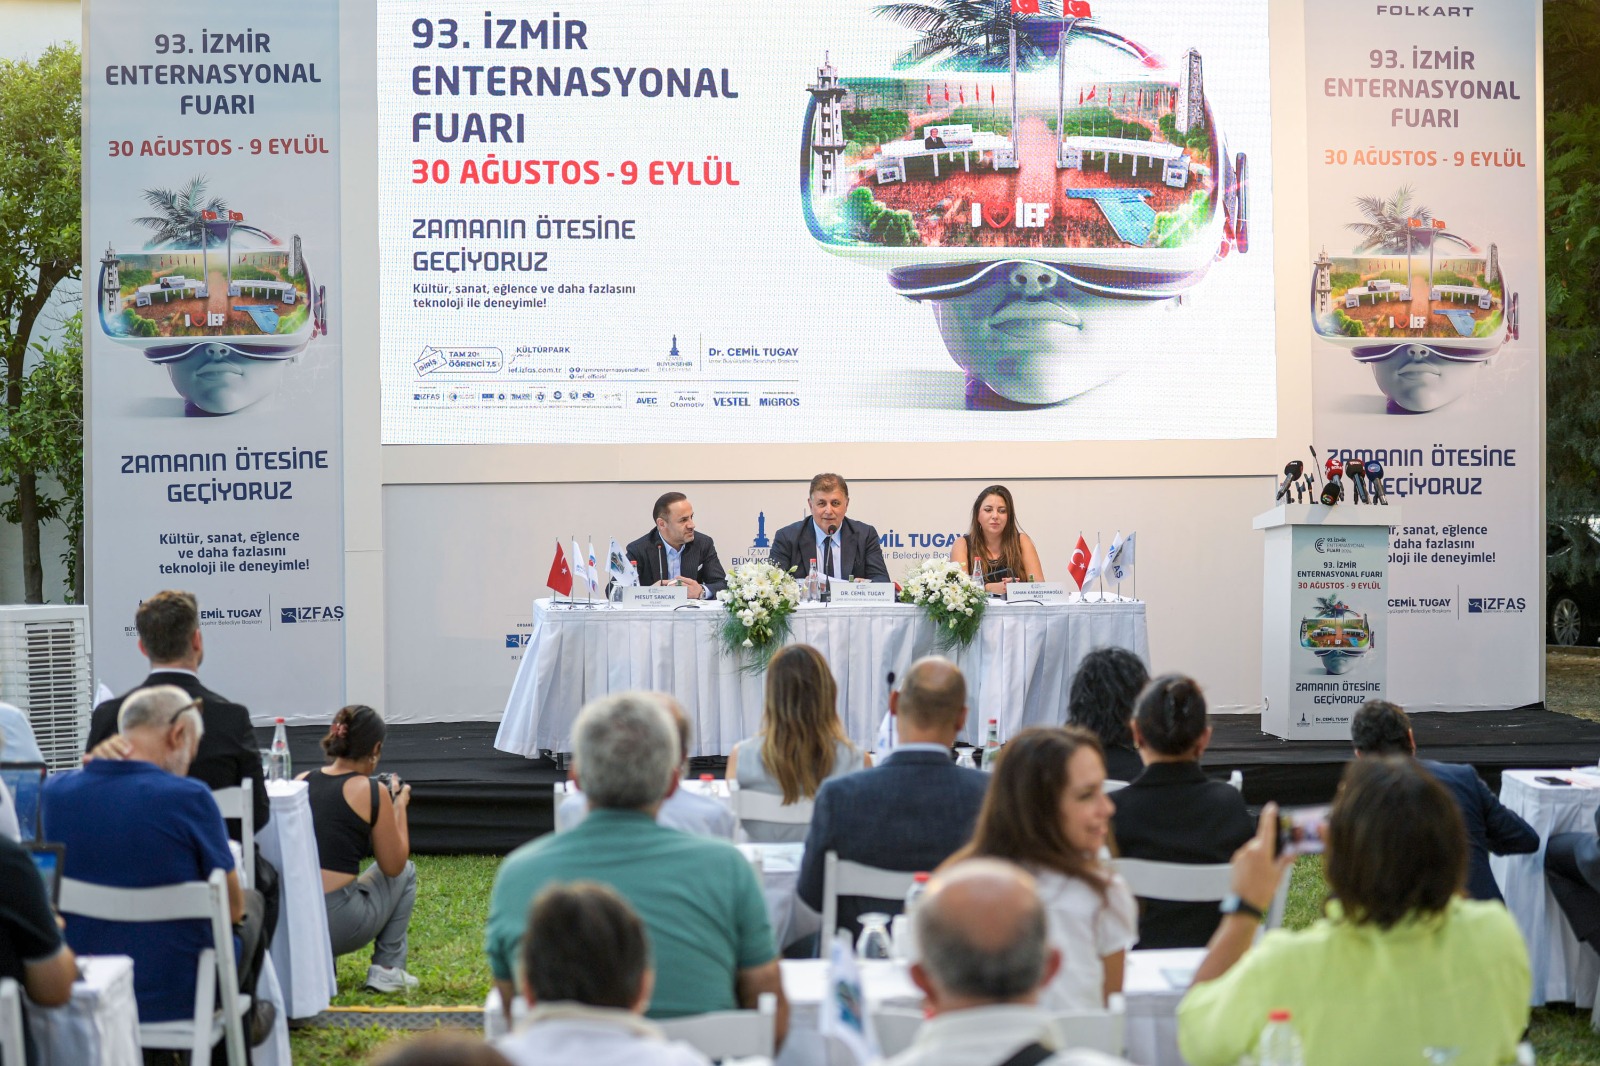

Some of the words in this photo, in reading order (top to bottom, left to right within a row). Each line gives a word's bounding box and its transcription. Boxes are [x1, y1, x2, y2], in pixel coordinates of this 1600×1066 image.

[1376, 5, 1474, 17] FOLKART
[411, 18, 470, 49] 93.
[483, 11, 588, 50] İZMİR
[154, 33, 194, 54] 93.
[202, 28, 270, 53] İZMİR
[1369, 49, 1404, 69] 93.
[1412, 45, 1475, 70] İZMİR
[105, 63, 322, 86] ENTERNASYONAL
[412, 65, 739, 99] ENTERNASYONAL
[1324, 78, 1520, 100] ENTERNASYONAL
[180, 94, 255, 115] FUARI
[1391, 108, 1459, 128] FUARI
[412, 112, 525, 143] FUARI
[108, 140, 134, 157] 30
[140, 135, 232, 157] AĞUSTOS
[249, 138, 262, 155] 9
[268, 134, 329, 155] EYLÜL
[1324, 149, 1348, 165] 30
[1353, 145, 1437, 167] AĞUSTOS
[1453, 151, 1465, 167] 9
[1470, 148, 1526, 168] EYLÜL
[412, 159, 450, 185] 30
[459, 153, 600, 185] AĞUSTOS
[620, 160, 638, 186] 9
[648, 155, 740, 186] EYLÜL
[412, 219, 526, 239] ZAMANIN
[536, 214, 636, 240] ÖTESİNE
[413, 247, 548, 273] GEÇİYORUZ
[413, 283, 452, 295] Kültür,
[455, 284, 490, 295] sanat,
[493, 283, 538, 296] eğlence
[541, 285, 555, 294] ve
[558, 283, 585, 294] daha
[588, 283, 636, 294] fazlasını
[413, 298, 464, 310] teknoloji
[467, 298, 481, 308] ile
[484, 298, 547, 310] deneyimle!
[708, 347, 725, 356] Dr.
[727, 345, 760, 356] CEMİL
[762, 347, 799, 356] TUGAY
[713, 397, 751, 406] VESTEL
[121, 453, 227, 474] ZAMANIN
[235, 447, 329, 471] ÖTESİNE
[1431, 443, 1516, 467] ÖTESİNE
[167, 478, 293, 504] GEÇİYORUZ
[159, 533, 203, 545] Kültür,
[207, 532, 246, 544] sanat,
[250, 531, 300, 545] eğlence
[1403, 525, 1439, 536] sanat,
[1442, 524, 1488, 537] eğlence
[1393, 538, 1422, 549] daha
[1426, 538, 1475, 549] fazlasını
[178, 549, 193, 558] ve
[197, 547, 229, 558] daha
[232, 546, 287, 557] fazlasını
[892, 551, 931, 560] Belediye
[1413, 552, 1428, 562] ile
[1431, 551, 1496, 565] deneyimle!
[159, 563, 217, 575] teknoloji
[220, 561, 235, 573] ile
[239, 559, 310, 574] deneyimle!
[1323, 561, 1335, 569] 93.
[1336, 560, 1357, 569] İZMİR
[1309, 580, 1345, 589] AĞUSTOS
[1351, 582, 1356, 590] 9
[1357, 581, 1381, 590] EYLÜL
[1387, 597, 1417, 607] CEMİL
[1419, 598, 1451, 607] TUGAY
[200, 607, 225, 619] EMİL
[227, 608, 262, 618] TUGAY
[1295, 682, 1339, 692] ZAMANIN
[1342, 680, 1381, 692] ÖTESİNE
[1314, 693, 1366, 705] GEÇİYORUZ
